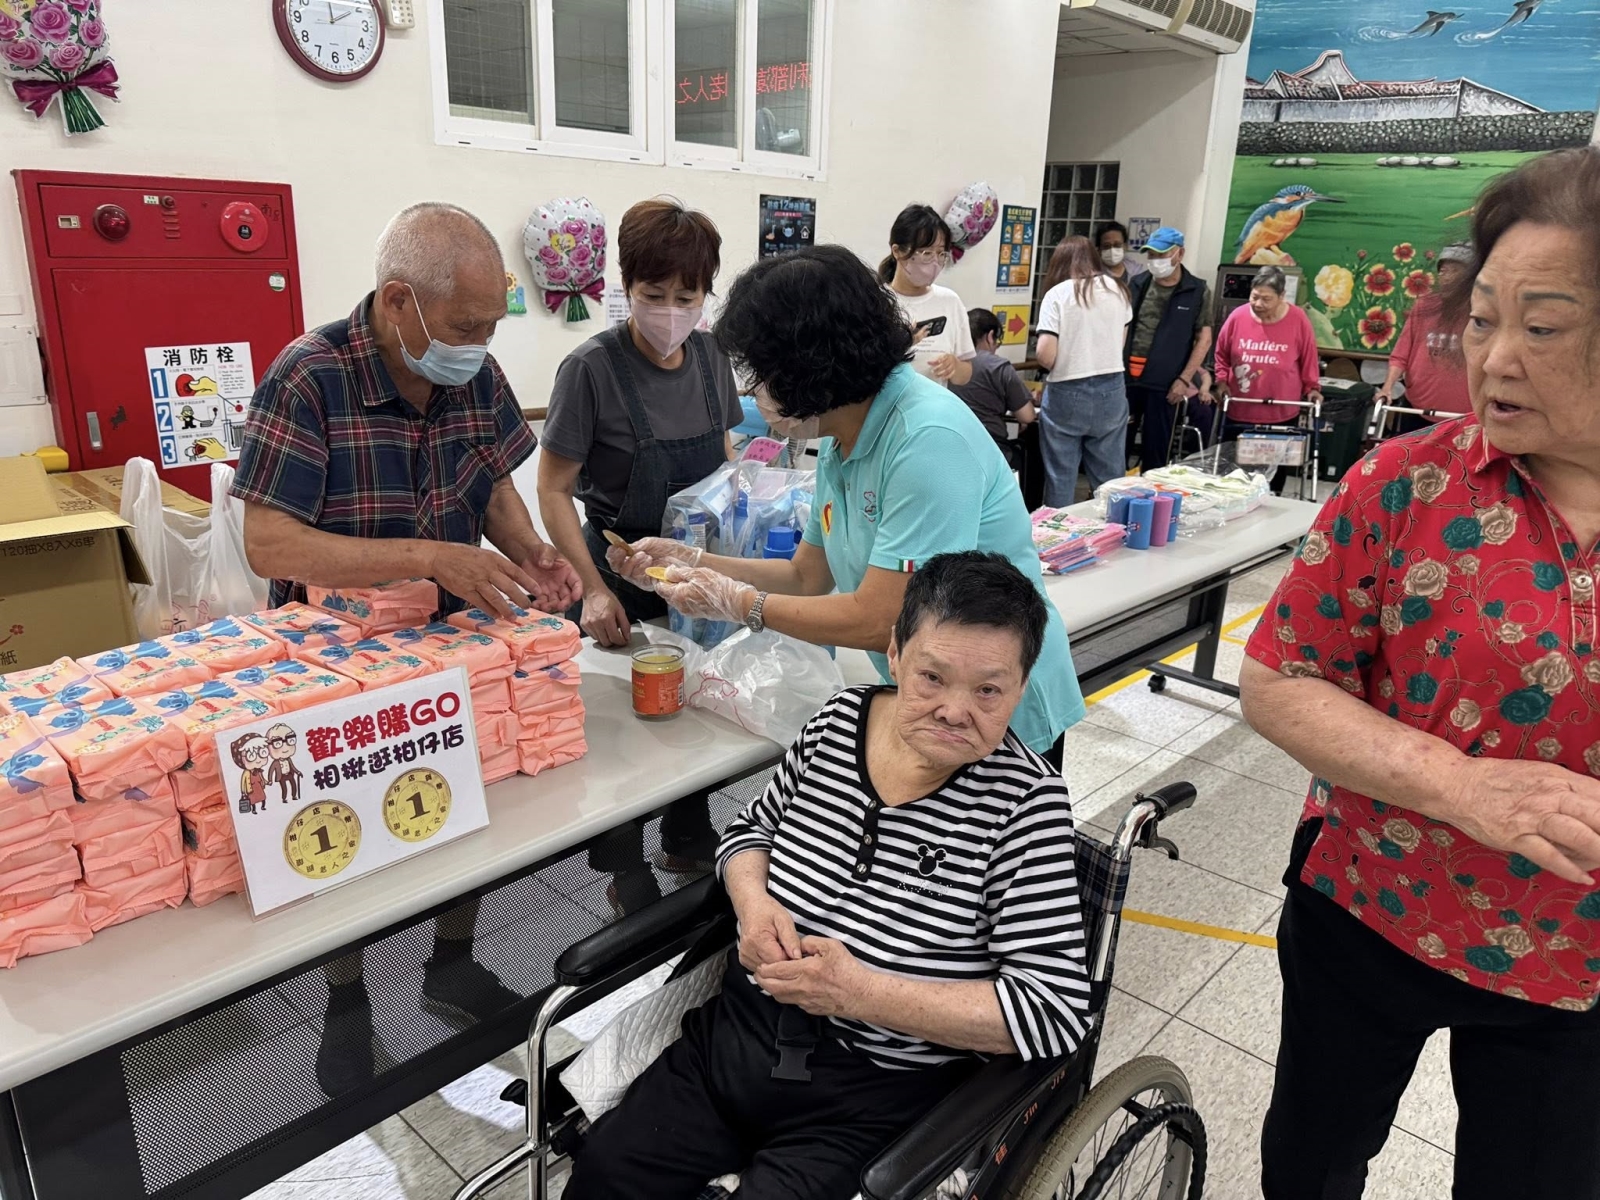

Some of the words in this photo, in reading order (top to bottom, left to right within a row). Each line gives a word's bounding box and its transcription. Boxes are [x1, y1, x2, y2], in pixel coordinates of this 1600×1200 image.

[293, 10, 302, 23] 9
[361, 20, 369, 33] 3
[301, 30, 309, 43] 8
[314, 44, 322, 57] 7
[358, 38, 365, 50] 4
[331, 51, 340, 64] 6
[347, 48, 355, 61] 5
[163, 346, 235, 367] 消防栓
[1241, 351, 1280, 365] brute.
[153, 370, 166, 397] 1
[157, 404, 172, 432] 2
[161, 438, 177, 463] 3
[0, 650, 18, 666] 紙
[405, 791, 431, 820] 1
[310, 825, 338, 856] 1
